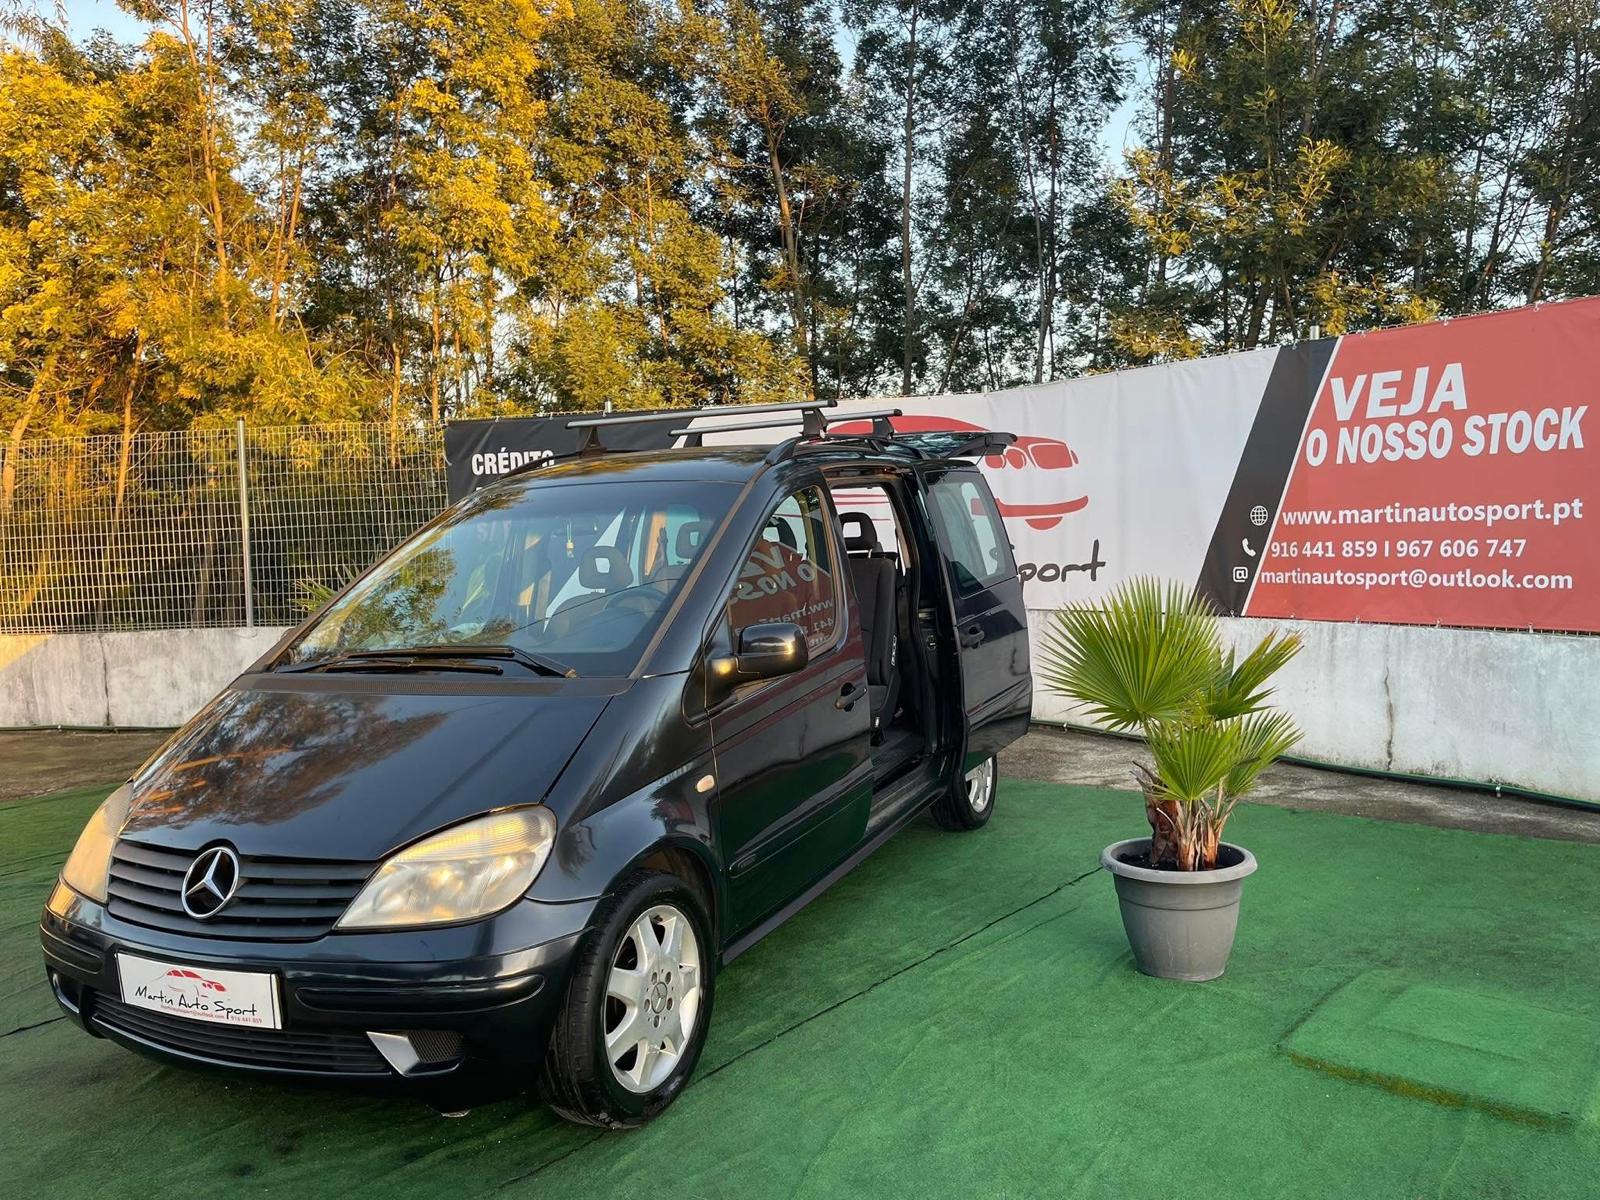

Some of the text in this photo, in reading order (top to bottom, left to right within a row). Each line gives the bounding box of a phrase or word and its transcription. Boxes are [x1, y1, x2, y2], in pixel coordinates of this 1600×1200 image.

[1330, 362, 1468, 421] VEJA
[1306, 406, 1588, 467] O NOSSO STOCK
[1282, 498, 1583, 527] www.martinautosport.pt
[1271, 541, 1298, 558] 916
[1301, 541, 1335, 557] 441
[1341, 540, 1378, 557] 859
[1396, 539, 1433, 557] 967
[1439, 539, 1479, 557] 606
[1486, 539, 1527, 557] 747
[1261, 568, 1573, 590] martinautosport@outlook.com
[134, 985, 257, 1020] Martin Auto Sport
